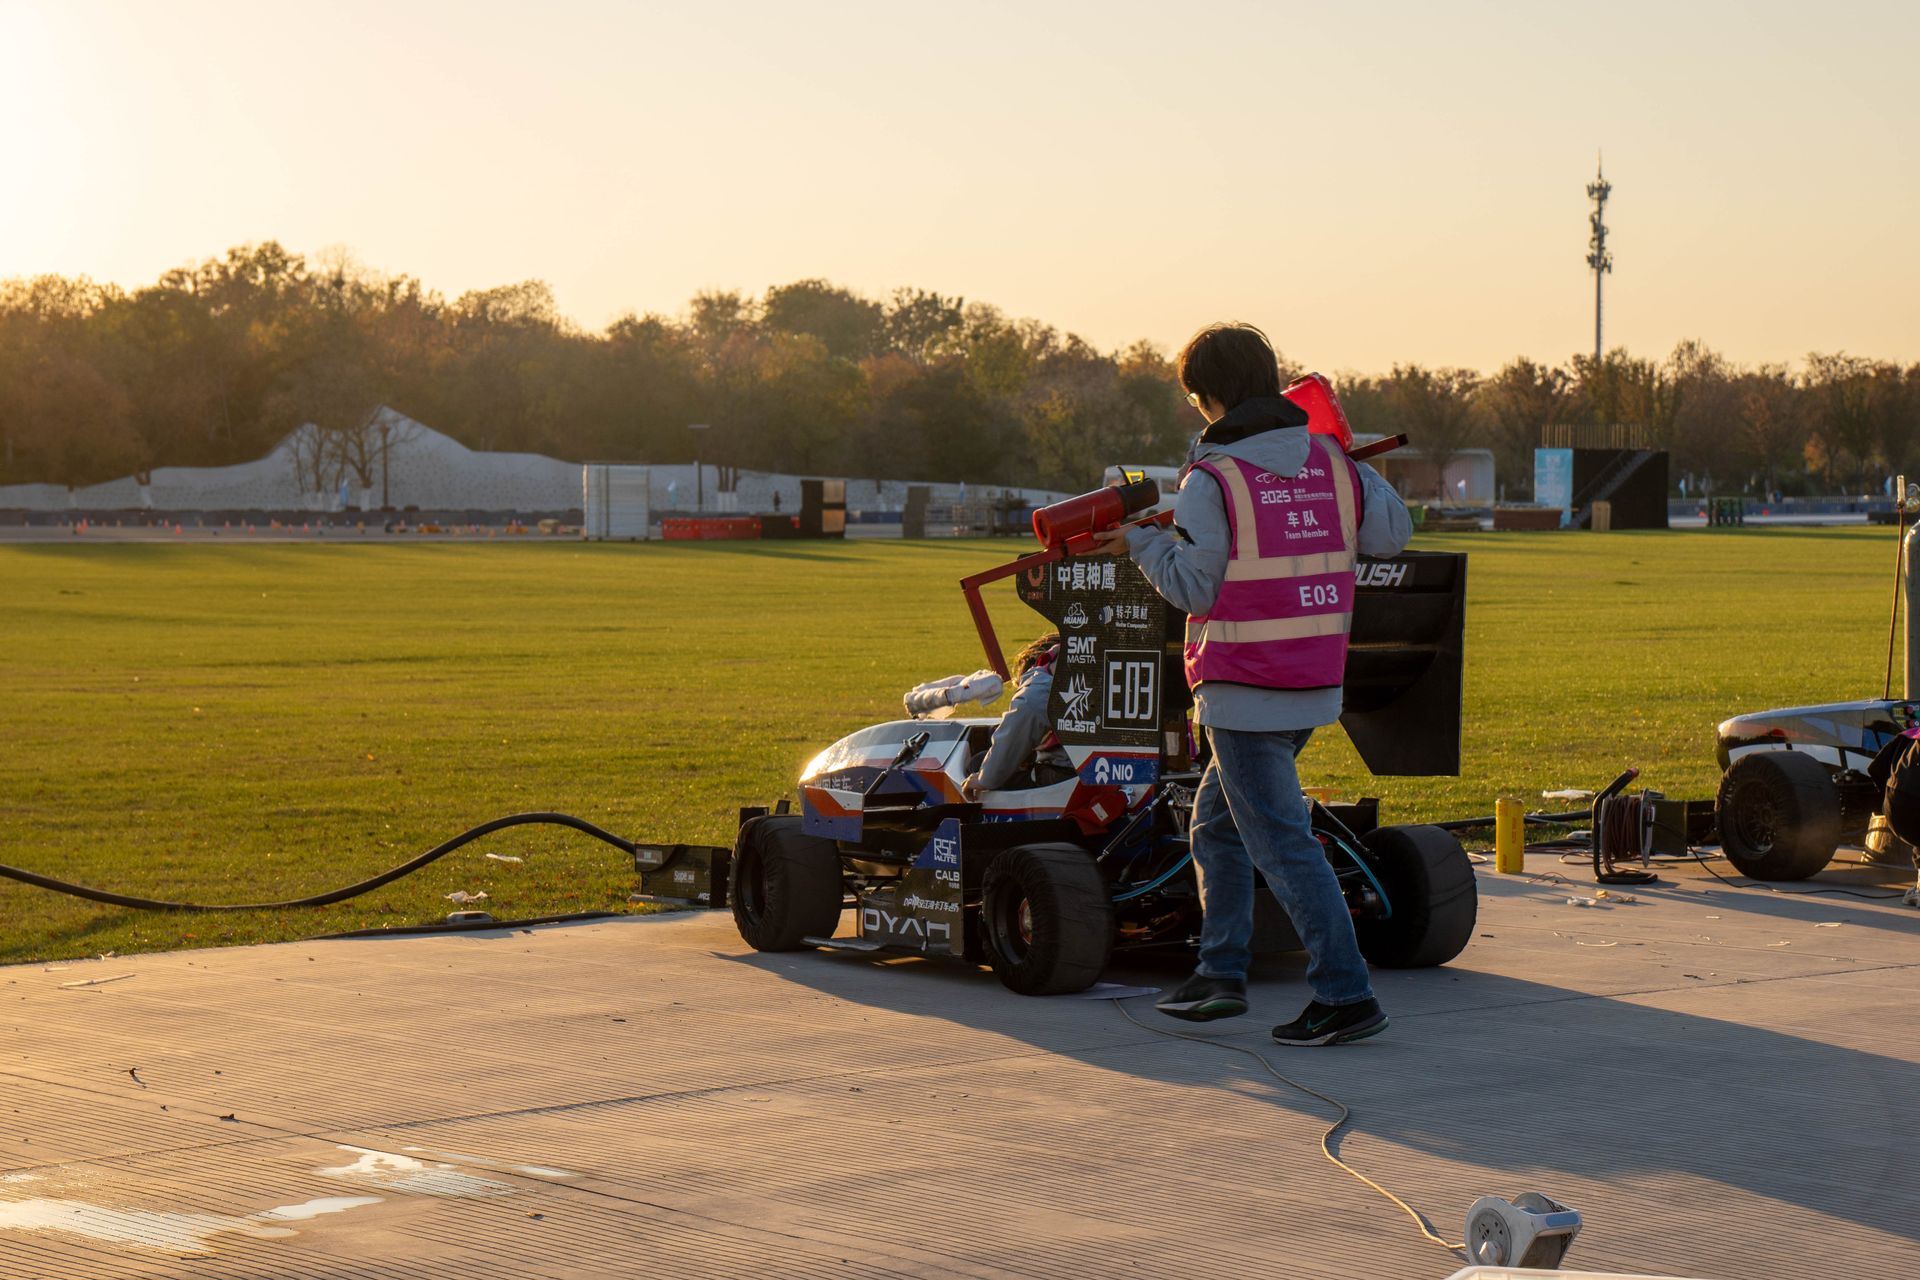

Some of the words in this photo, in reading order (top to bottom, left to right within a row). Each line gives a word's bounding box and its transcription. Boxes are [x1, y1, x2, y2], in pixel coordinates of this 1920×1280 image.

[1260, 489, 1292, 504] 2025
[1287, 510, 1319, 528] 车队
[1284, 531, 1302, 540] Team
[1302, 529, 1329, 539] Member
[1057, 561, 1117, 592] 中复神鹰
[1355, 563, 1408, 587] USH
[1299, 583, 1339, 607] E03
[1063, 616, 1089, 625] HUAHAI
[1066, 636, 1097, 654] SMT
[1066, 655, 1097, 665] MASTA
[1107, 661, 1155, 720] E03
[1112, 763, 1134, 782] NIO
[935, 869, 960, 882] CALB
